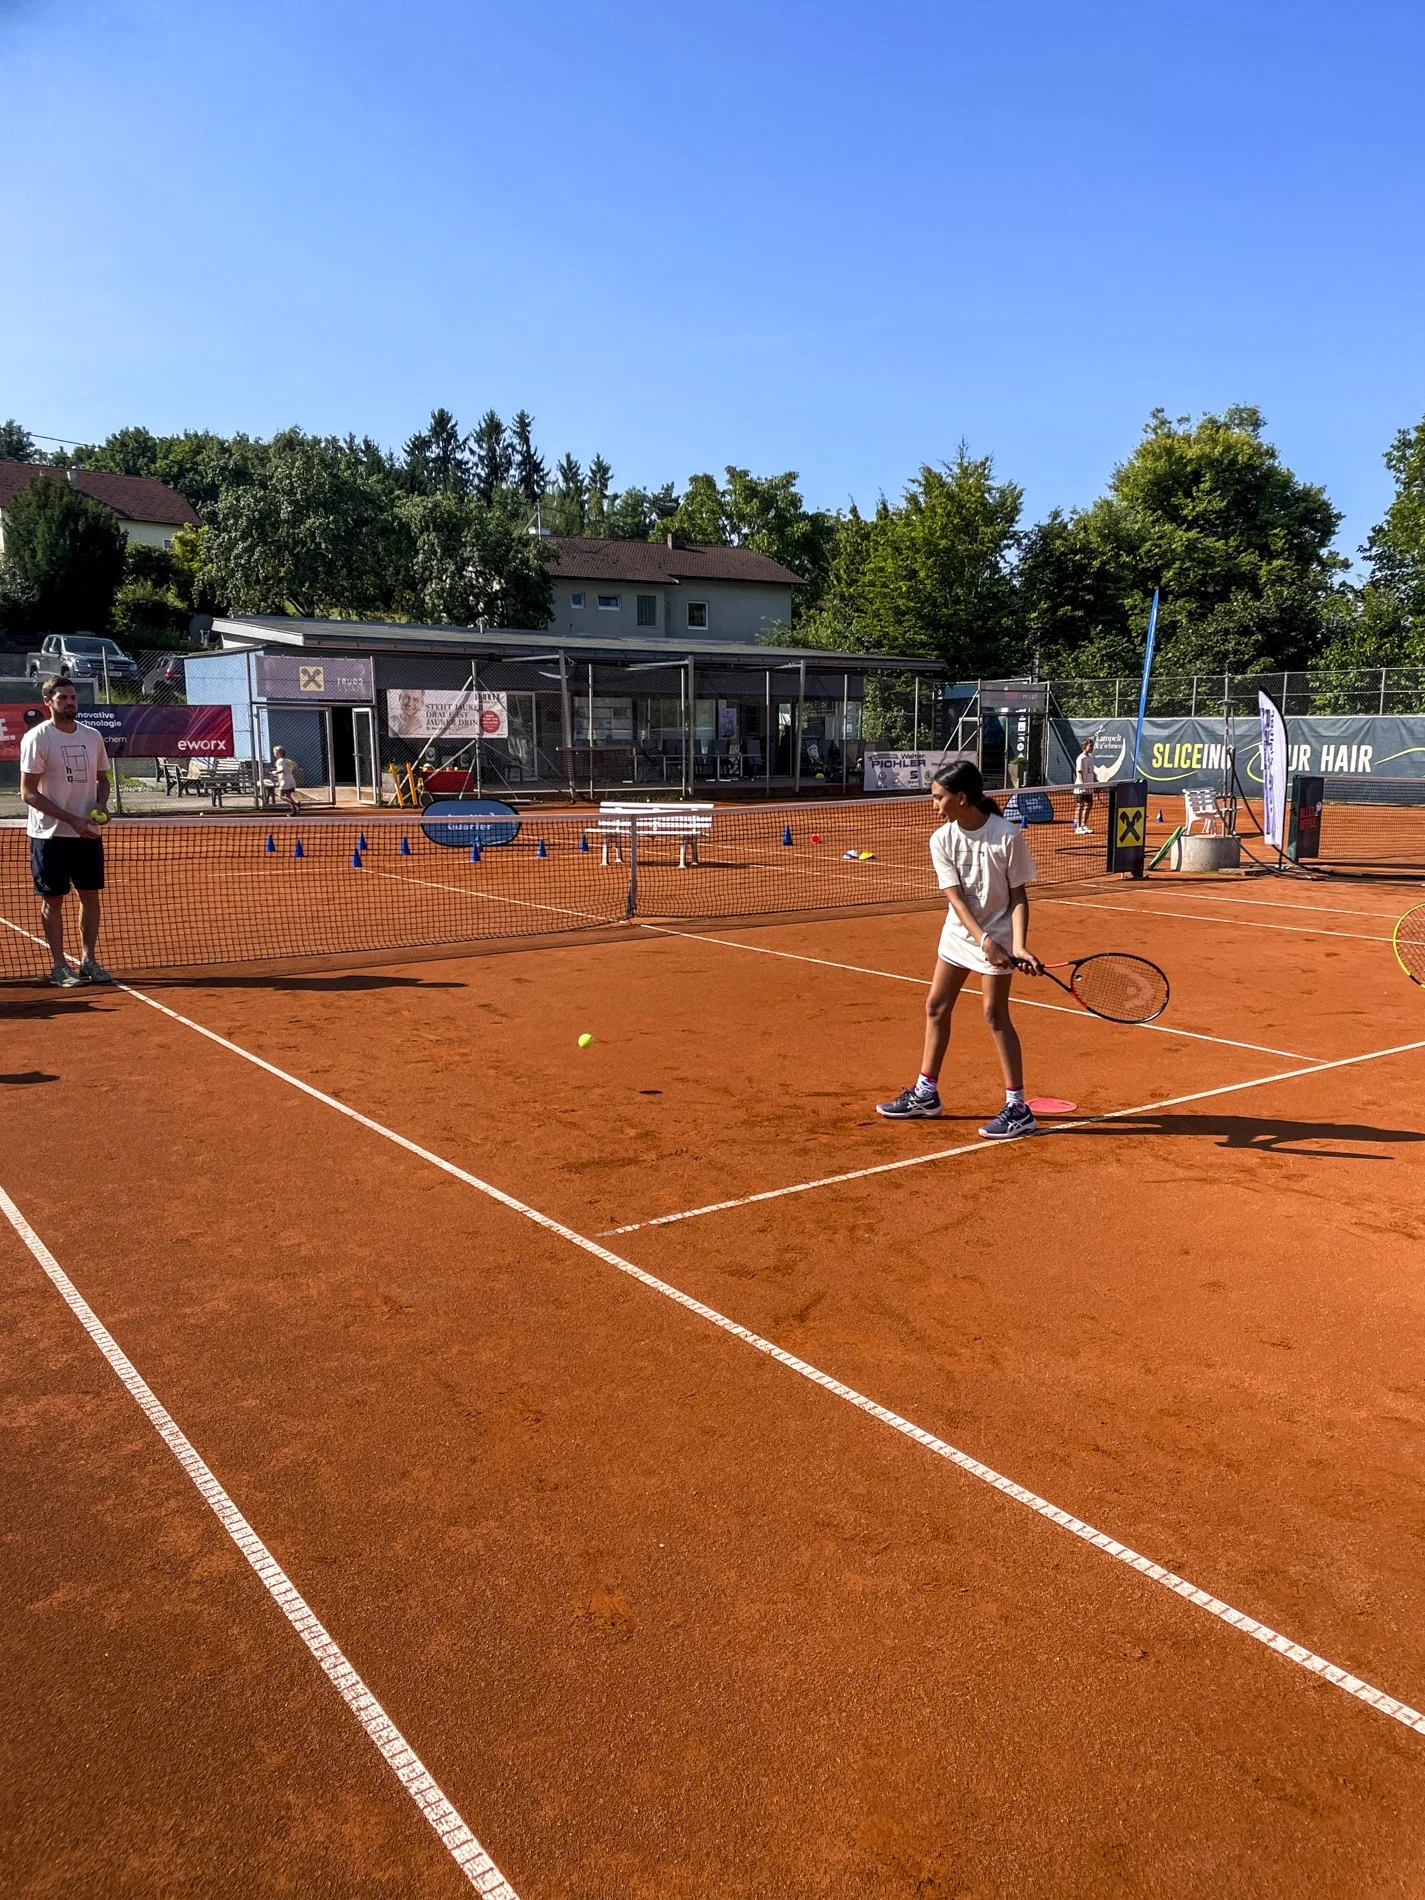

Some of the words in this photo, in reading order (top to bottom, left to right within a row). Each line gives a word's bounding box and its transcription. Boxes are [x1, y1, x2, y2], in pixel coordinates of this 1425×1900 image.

[76, 711, 115, 719] novative
[80, 719, 122, 728] chnologie
[177, 739, 226, 751] eworx
[1258, 744, 1312, 772] UR
[1320, 744, 1373, 773] HAIR
[871, 759, 926, 769] PICHLER
